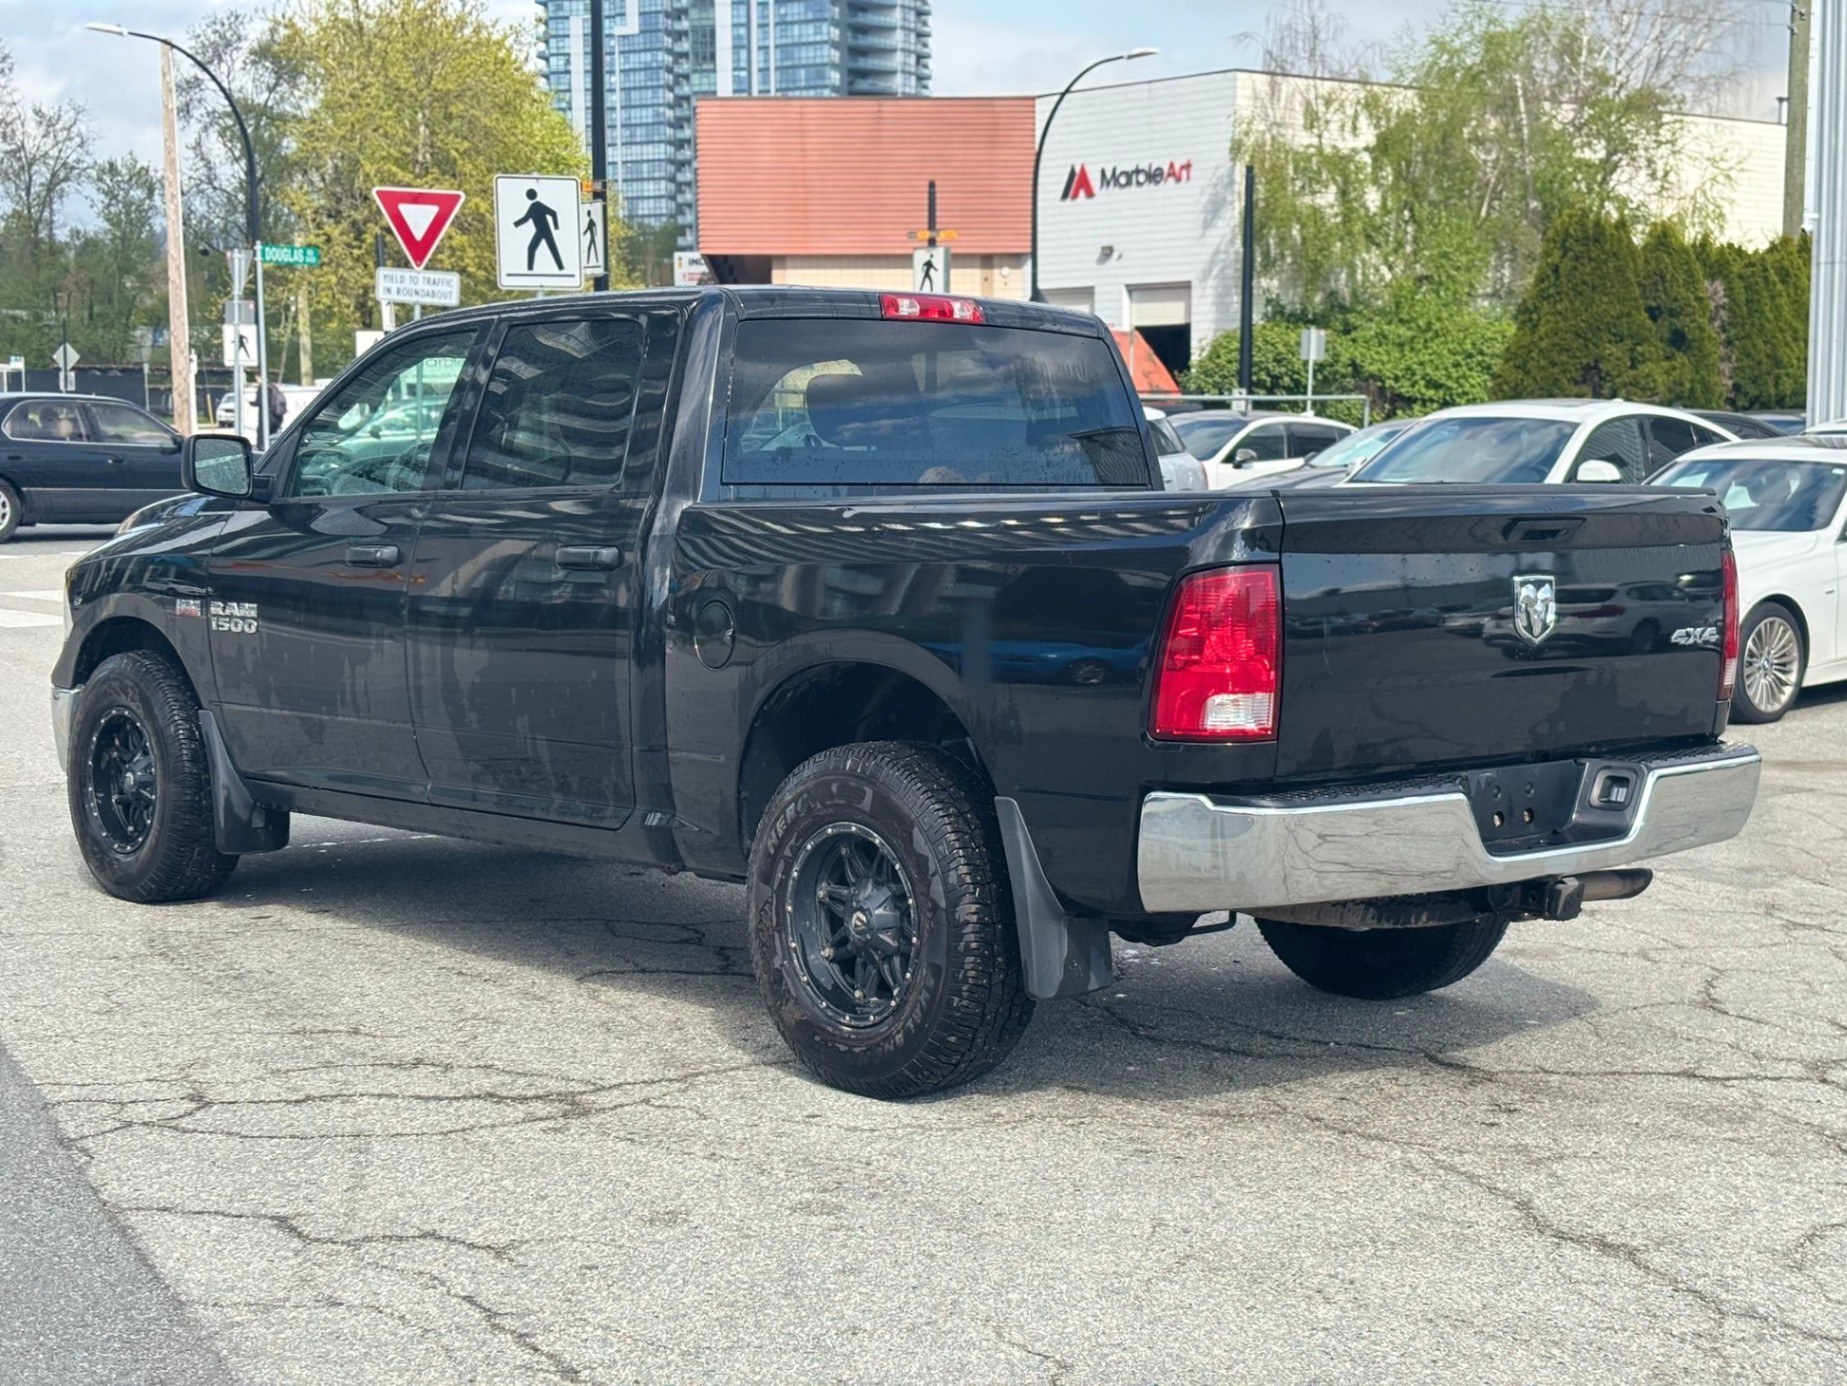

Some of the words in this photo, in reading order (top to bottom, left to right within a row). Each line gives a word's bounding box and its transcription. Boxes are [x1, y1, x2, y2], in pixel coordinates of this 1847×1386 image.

[264, 247, 304, 262] DOUGLAS
[383, 274, 405, 284] YIELD
[409, 275, 419, 285] TO
[422, 277, 453, 288] TRAFFIC
[383, 287, 391, 295] IN
[396, 288, 453, 300] ROUNDABOUT
[210, 601, 257, 617] RAM
[211, 616, 258, 634] 1500
